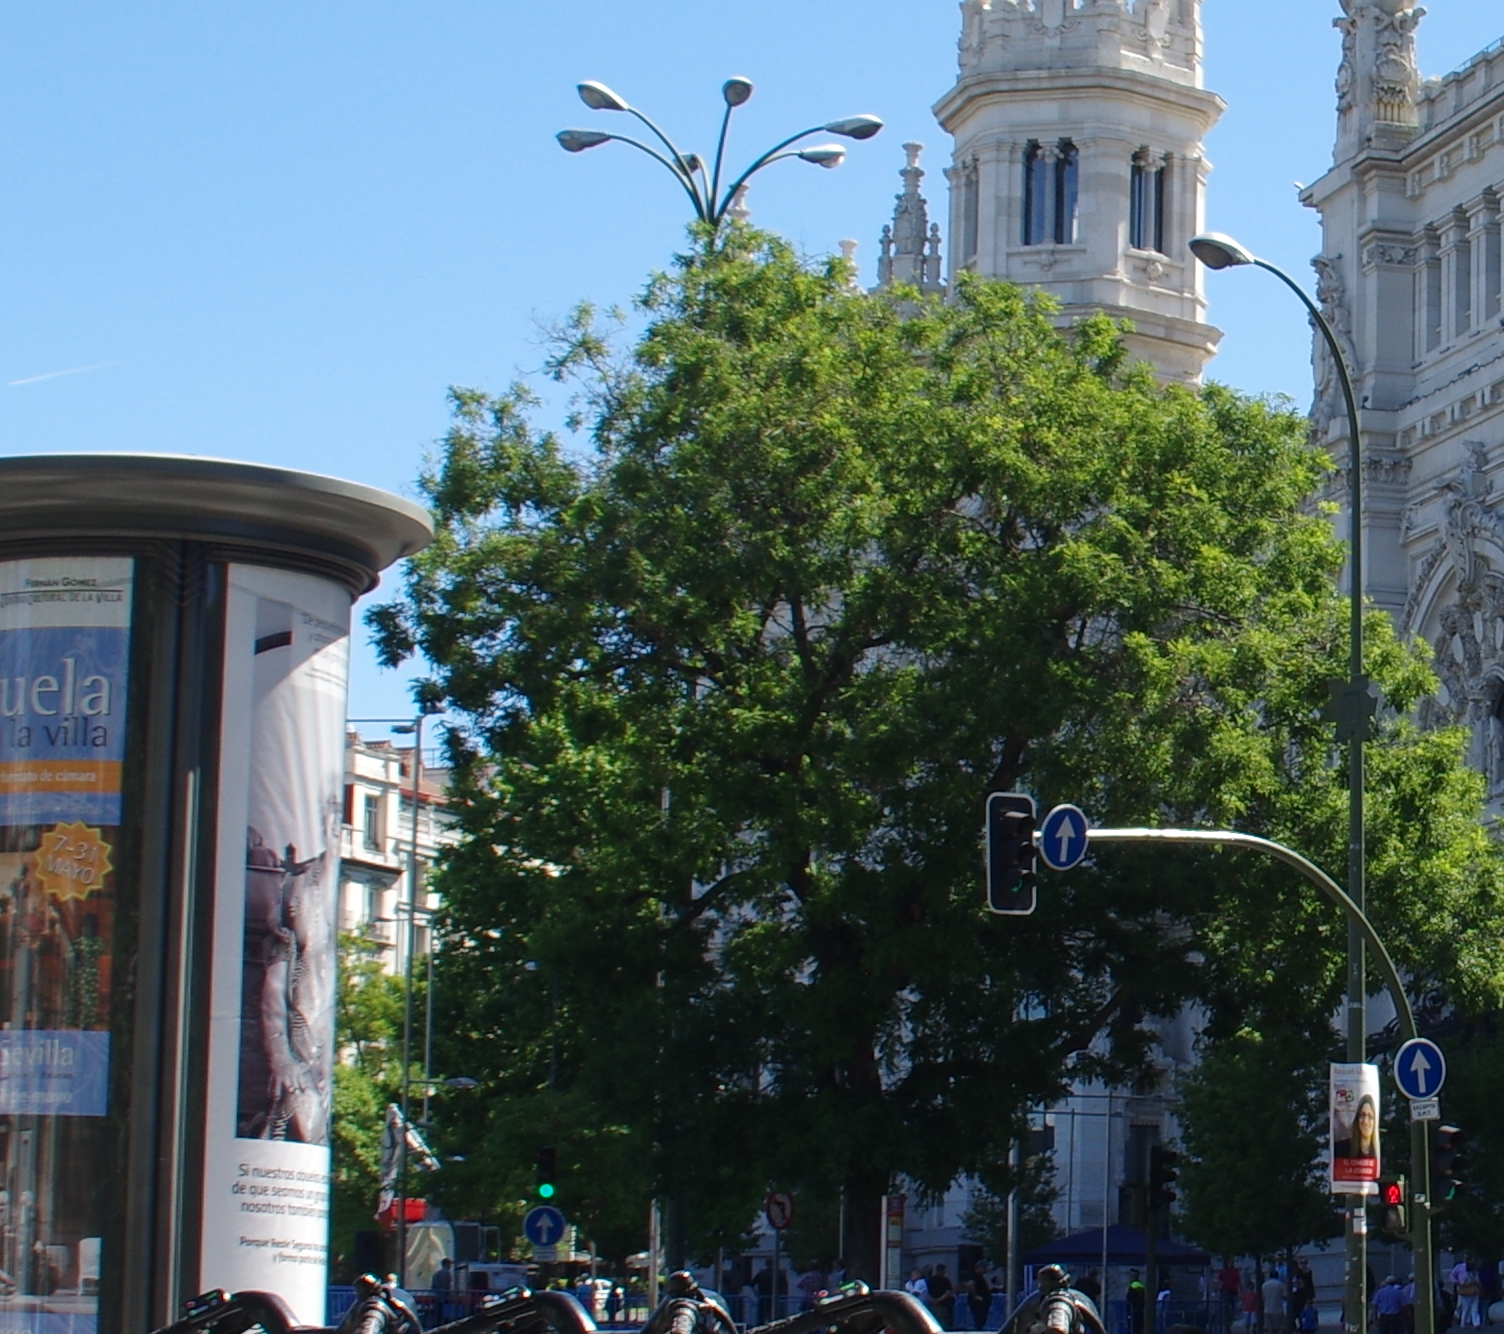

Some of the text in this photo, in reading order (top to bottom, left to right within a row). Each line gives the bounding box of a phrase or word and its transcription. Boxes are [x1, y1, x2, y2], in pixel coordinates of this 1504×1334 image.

[7, 717, 32, 748] la
[43, 716, 108, 747] villa
[54, 769, 97, 783] cámara
[53, 835, 100, 863] 7-31
[47, 854, 96, 885] MAYO
[0, 1038, 75, 1067] Sevilla
[238, 1163, 250, 1177] Si
[251, 1166, 295, 1181] nuestros
[231, 1181, 247, 1195] de
[249, 1184, 270, 1198] que
[240, 1200, 286, 1215] nosotros
